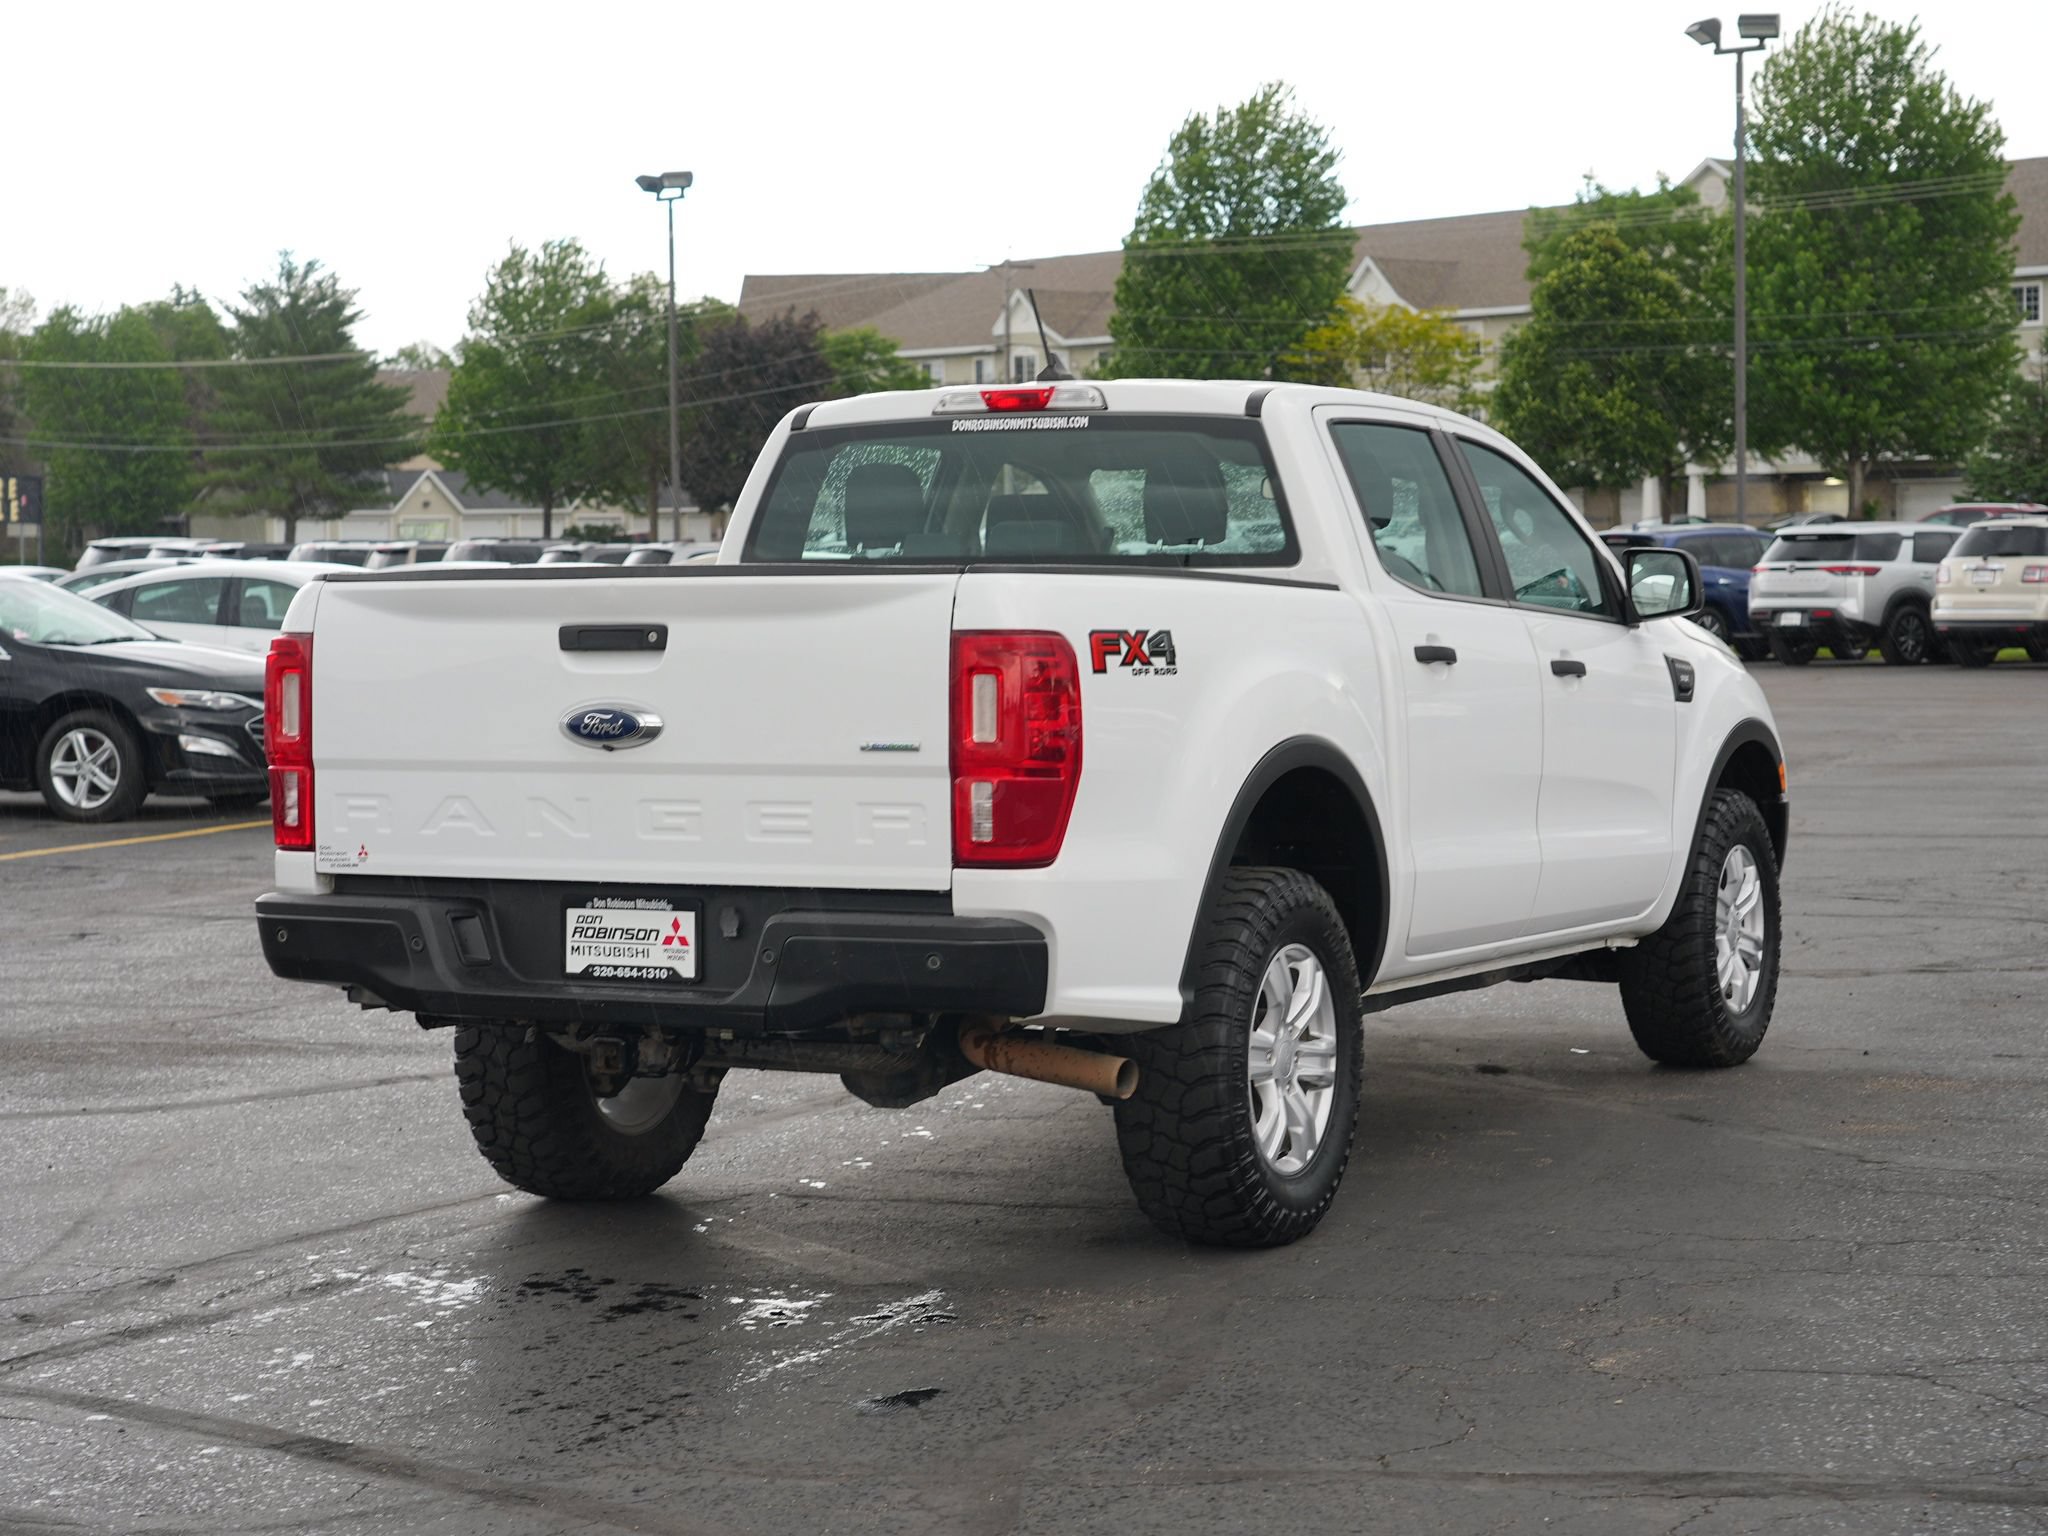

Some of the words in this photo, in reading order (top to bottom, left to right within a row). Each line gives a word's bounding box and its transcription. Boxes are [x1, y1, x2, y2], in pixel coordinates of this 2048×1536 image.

[951, 416, 1090, 432] DONROBINSONMITSUBISHI.COM
[1089, 629, 1176, 674] FX4
[1132, 668, 1150, 676] OFF
[1154, 667, 1178, 676] ROAD
[580, 712, 624, 736] Ford
[334, 793, 928, 846] RANGER
[576, 915, 603, 924] DON
[571, 926, 660, 941] ROBINSON
[570, 945, 650, 959] MITSUBISHI
[593, 966, 668, 979] 320-654-1310
